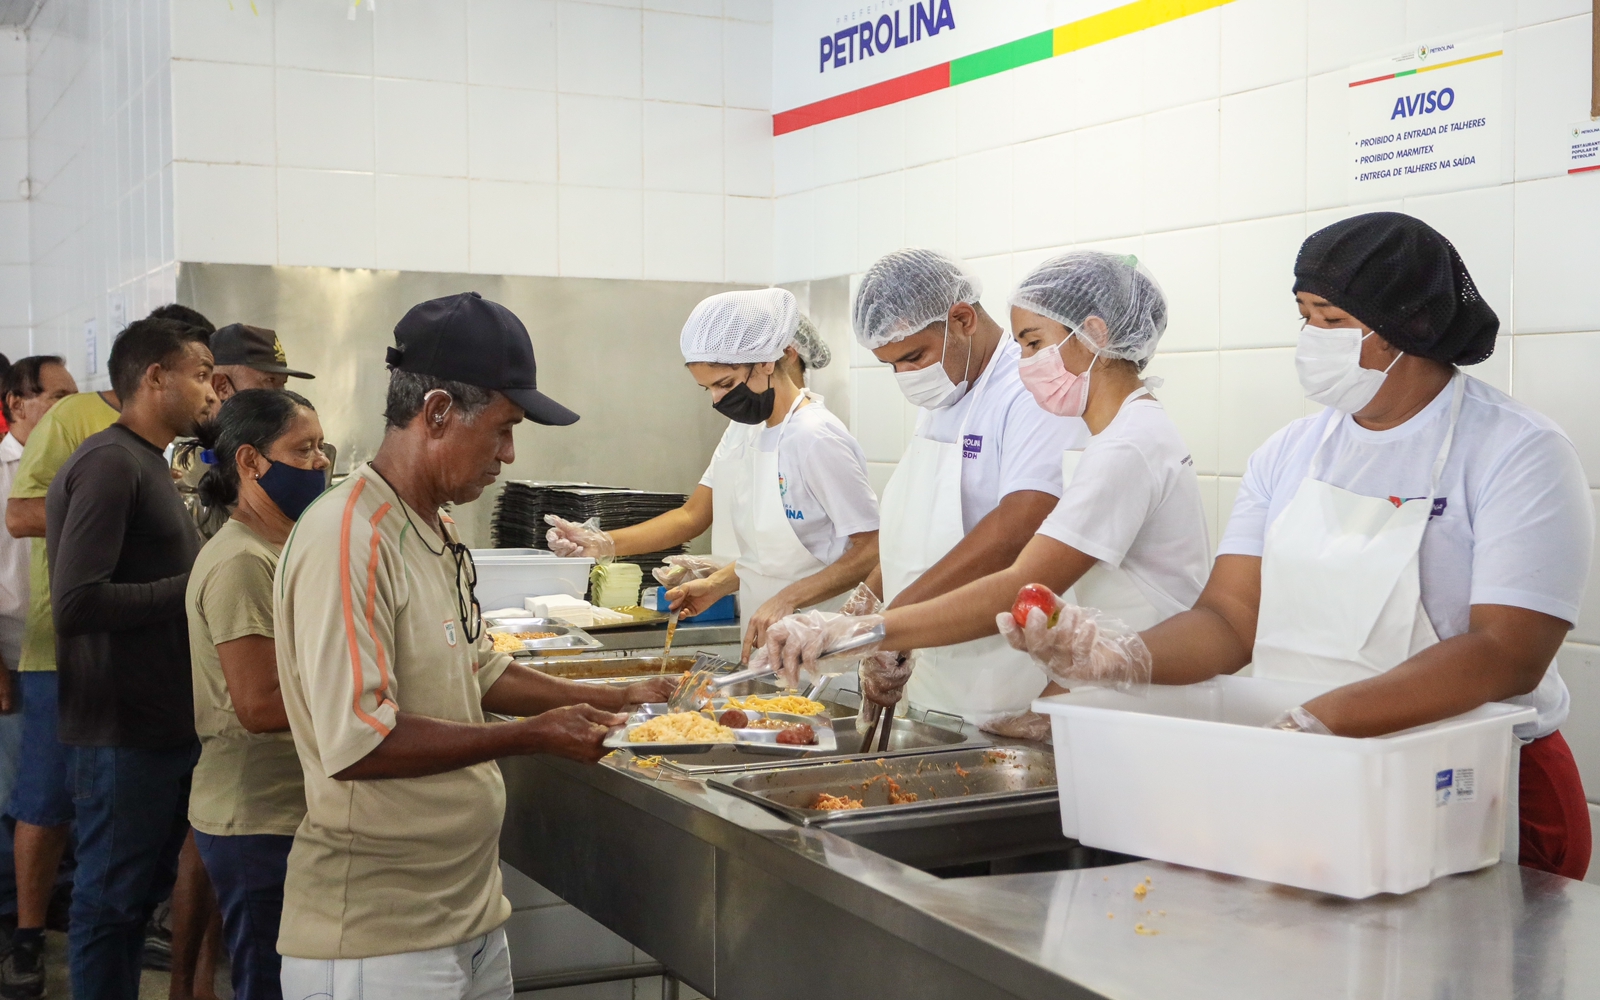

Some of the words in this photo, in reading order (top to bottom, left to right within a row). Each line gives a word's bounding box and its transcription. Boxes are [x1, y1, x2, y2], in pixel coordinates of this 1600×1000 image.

[820, 0, 955, 73] PETROLINA
[1430, 44, 1454, 54] PETROLINA
[1391, 88, 1454, 120] AVISO
[1360, 134, 1394, 147] PROIBIDO
[1396, 133, 1402, 141] A
[1404, 126, 1436, 140] ENTRADA
[1439, 124, 1448, 133] DE
[1450, 118, 1486, 131] TALHERES
[1360, 152, 1394, 164] PROIBIDO
[1396, 145, 1434, 159] MARMITEX
[1360, 169, 1391, 181] ENTREGA
[1393, 167, 1402, 176] DE
[1404, 162, 1437, 174] TALHERES
[1439, 160, 1450, 169] NA
[1453, 154, 1476, 167] SAÍDA
